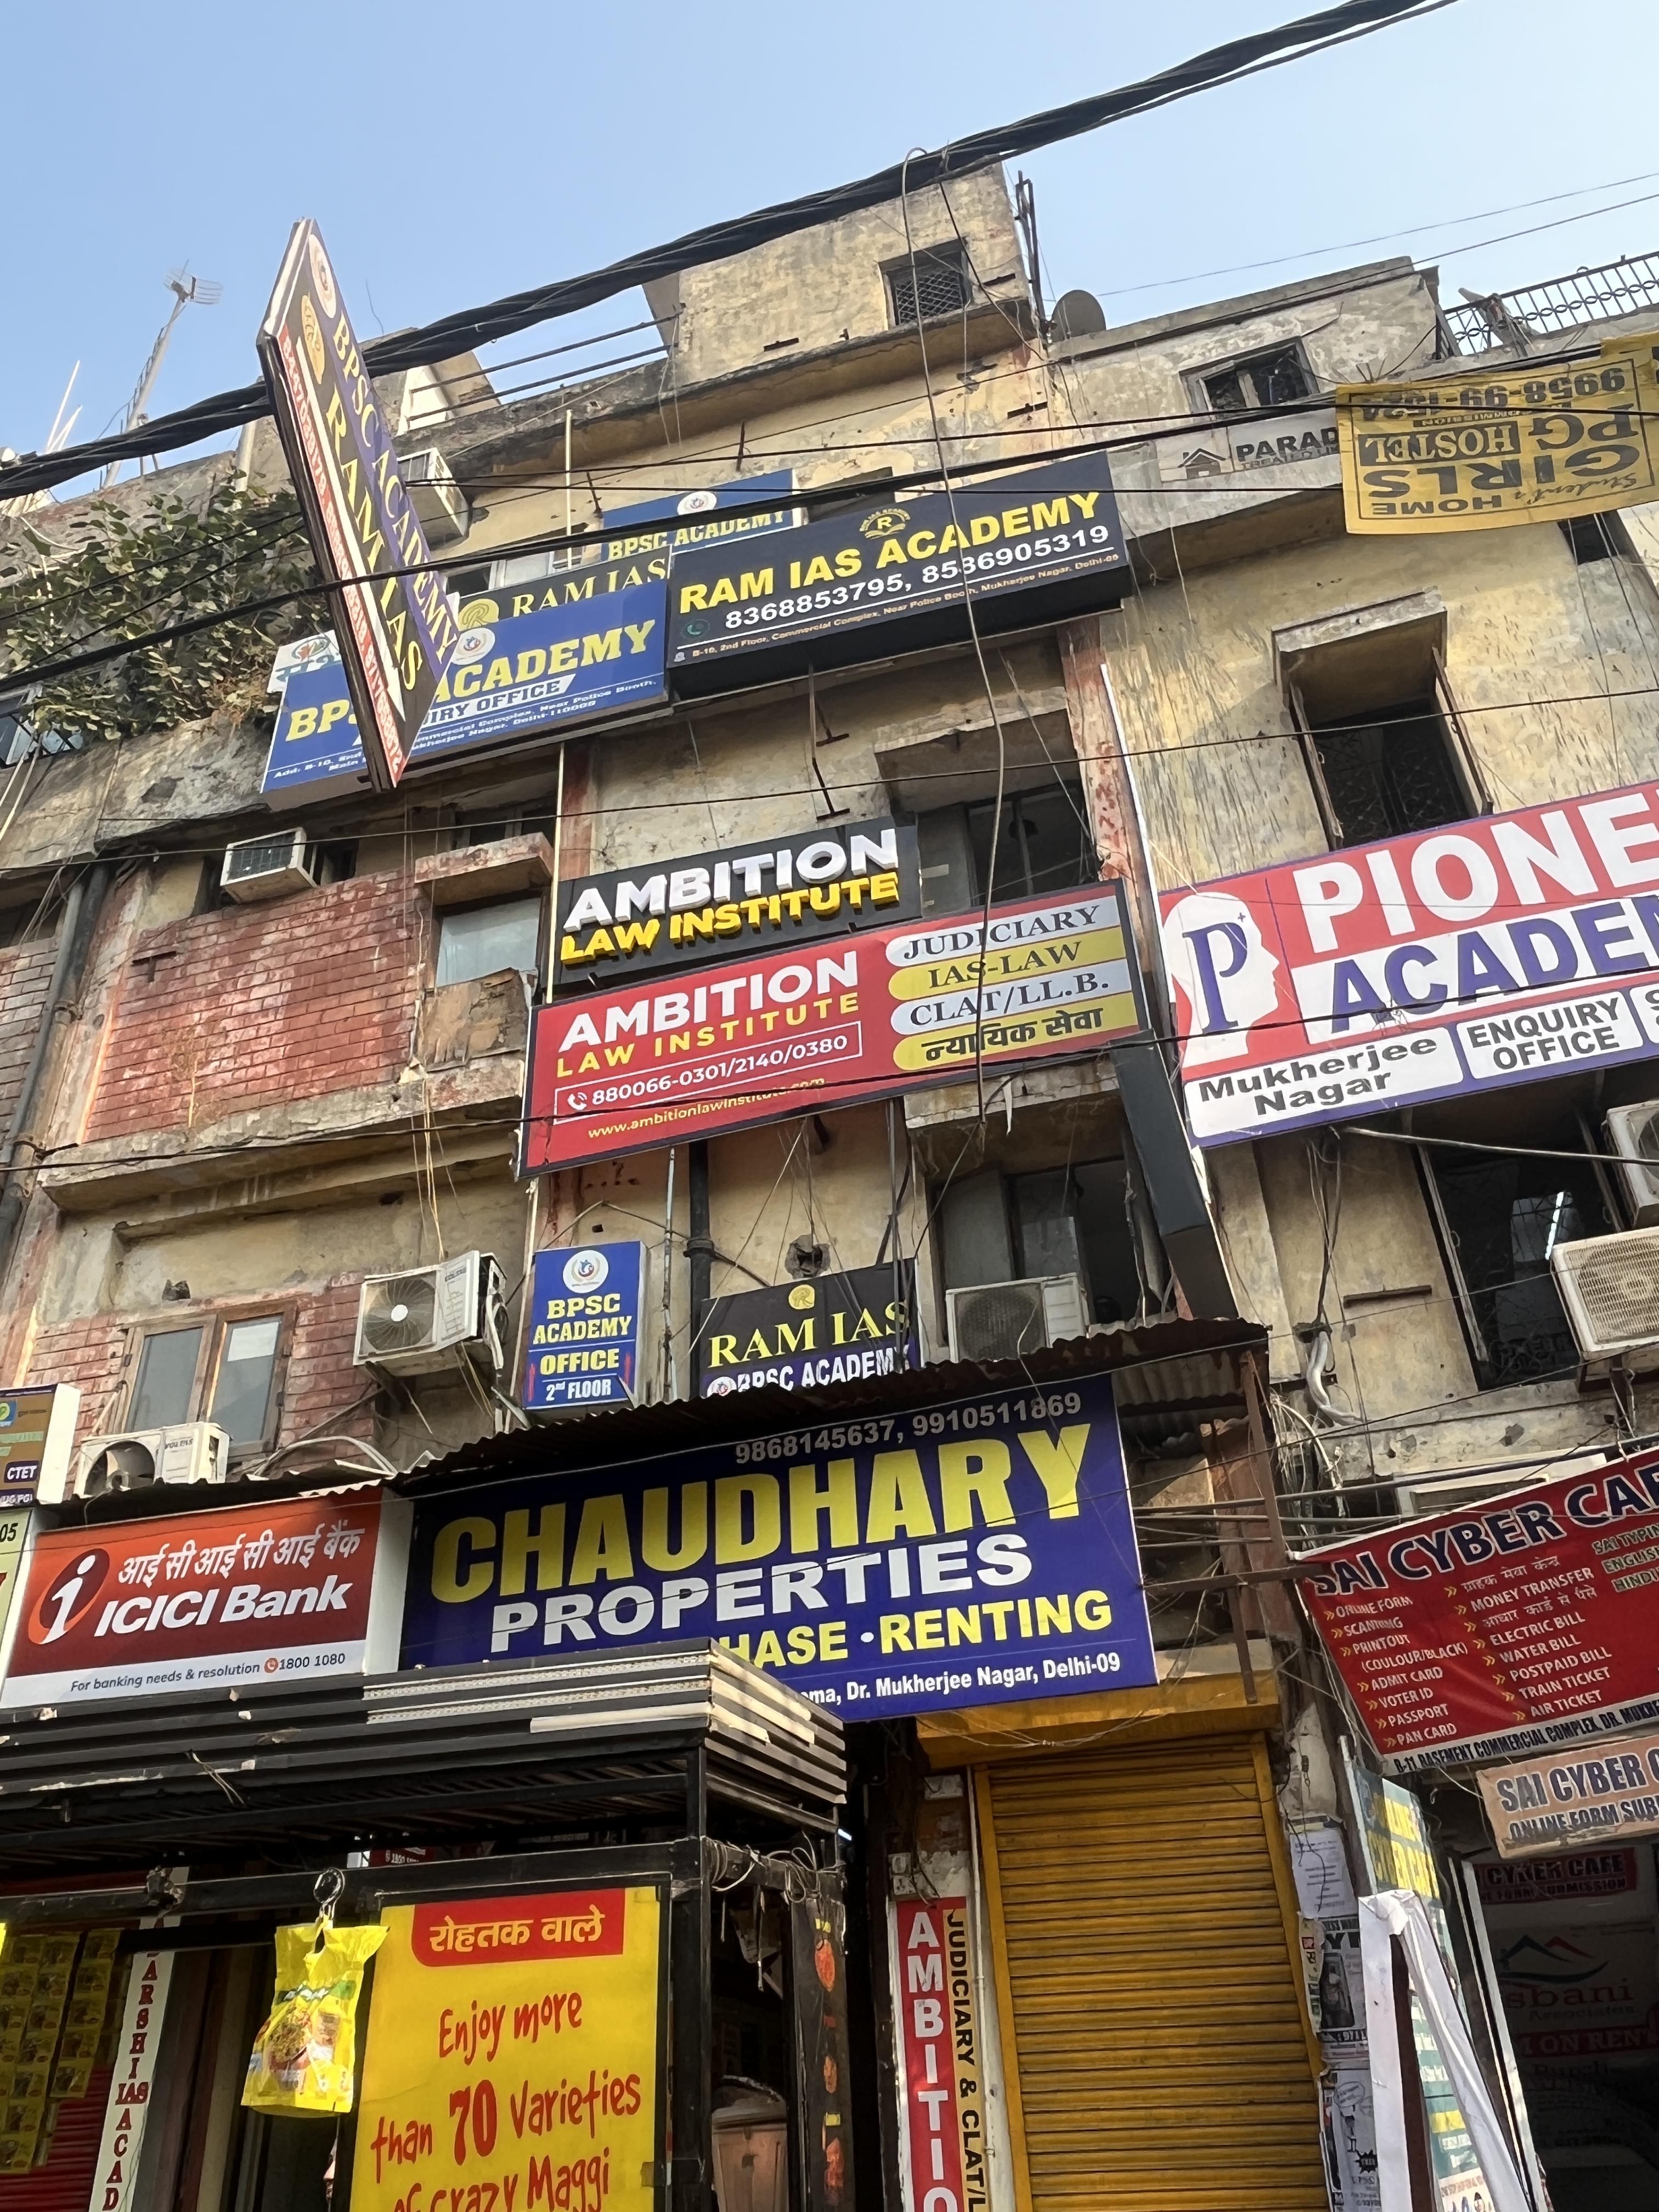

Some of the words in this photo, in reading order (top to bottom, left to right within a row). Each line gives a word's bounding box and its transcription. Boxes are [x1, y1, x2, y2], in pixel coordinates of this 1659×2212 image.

[332, 309, 379, 448] BPSC
[1365, 425, 1514, 463] HOSTEL
[1528, 403, 1639, 450] PG
[1363, 444, 1640, 498] GIRLS
[1372, 495, 1502, 515] HOME
[325, 382, 385, 573] RAM
[380, 575, 423, 691] IAS
[607, 531, 668, 562] BPSC
[680, 568, 774, 614] RAM
[790, 549, 862, 589] IAS
[876, 492, 1099, 569] ACADEMY
[512, 576, 596, 618] RAM
[607, 556, 668, 592] IAS
[725, 573, 912, 629] 8368853795,
[771, 622, 832, 641] Commercial
[477, 680, 561, 712] OFFICE
[563, 828, 899, 932] AMBITION
[1293, 788, 1659, 953] PIONE
[561, 918, 660, 965] LAW
[669, 872, 900, 945] INSTITUTE
[904, 905, 1099, 960] JUDICIARY
[928, 941, 1082, 989] IAS-LAW
[1183, 922, 1248, 1035] P
[558, 951, 859, 1053] AMBITION
[910, 972, 1109, 1026] CLAT/LL.B.
[1467, 997, 1618, 1048] ENQUIRY
[557, 1043, 635, 1078] LAW
[655, 992, 859, 1057] INSTITUTE
[921, 1020, 1037, 1062] न्यायिक
[1042, 1007, 1104, 1037] सेवा
[1493, 1026, 1620, 1070] OFFICE
[592, 1035, 848, 1106] 880066-0301/2140/0380
[1200, 1037, 1438, 1104] Mukherjee
[1255, 1069, 1392, 1116] Nagar
[547, 1293, 620, 1319] BPSC
[533, 1316, 632, 1345] ACADEMY
[708, 1317, 817, 1368] RAM
[831, 1301, 909, 1345] IAS
[540, 1348, 619, 1375] OFFICE
[567, 1379, 611, 1399] FLOOR
[736, 1420, 903, 1464] 9868145637,
[912, 1392, 1082, 1437] 9910511869
[7, 1465, 38, 1481] CTET
[431, 1423, 1091, 1605] CHAUDHARY
[1388, 1501, 1567, 1580] CYBER
[94, 1588, 220, 1637] ICICI
[220, 1575, 354, 1623] Bank
[491, 1534, 1032, 1659] PROPERTIES
[1378, 1596, 1414, 1612] FORM
[1471, 1588, 1520, 1612] MONEY
[1521, 1567, 1594, 1597] TRANSFER
[718, 1621, 848, 1669] HASE
[880, 1590, 1113, 1655] RENTING
[1352, 1634, 1411, 1654] PRINTOUT
[1490, 1620, 1554, 1645] ELECTRIC
[1553, 1611, 1585, 1629] BILL
[1499, 1643, 1549, 1663] WATER
[1548, 1634, 1582, 1651] BILL
[71, 1680, 92, 1692] For
[93, 1674, 143, 1693] banking
[146, 1670, 183, 1687] needs
[185, 1668, 196, 1681] &
[198, 1662, 261, 1680] resolution
[279, 1657, 310, 1671] 1800
[314, 1652, 346, 1668] 1080
[847, 1680, 870, 1700] Dr.
[876, 1671, 972, 1697] Mukherjee
[978, 1661, 1039, 1688] Nagar,
[1043, 1652, 1121, 1679] Delhi-09
[1372, 1672, 1411, 1690] ADMIT
[1410, 1666, 1443, 1682] CARD
[1510, 1655, 1579, 1681] POSTPAID
[1579, 1646, 1612, 1664] BILL
[1519, 1681, 1563, 1699] TRAIN
[1562, 1666, 1611, 1688] TICKET
[1378, 1691, 1420, 1708] VOTER
[1419, 1687, 1434, 1700] ID
[1387, 1703, 1449, 1726] PASSPORT
[1530, 1702, 1555, 1717] AIR
[1554, 1689, 1602, 1711] TICKET
[1396, 1730, 1424, 1745] PAN
[1424, 1723, 1457, 1739] CARD
[1418, 1743, 1473, 1770] BASEMENT
[1472, 1728, 1548, 1758] COMMERCIAL
[1496, 1772, 1549, 1813] SAI
[1548, 1753, 1650, 1803] CYBER
[1568, 1803, 1620, 1829] FORM
[1619, 1794, 1659, 1822] SUB
[1567, 1854, 1624, 1877] CAFE
[430, 1915, 533, 1953] रोहतक
[541, 1904, 605, 1944] वाले
[947, 1909, 975, 2067] JUDICIARY
[439, 2000, 506, 2066] Enjoy
[514, 1991, 582, 2044] more
[115, 2081, 150, 2106] IAS
[959, 2078, 978, 2099] &
[371, 2116, 432, 2184] than
[449, 2079, 498, 2166] 70
[510, 2069, 641, 2140] Varieties
[527, 2147, 610, 2212] Maggi
